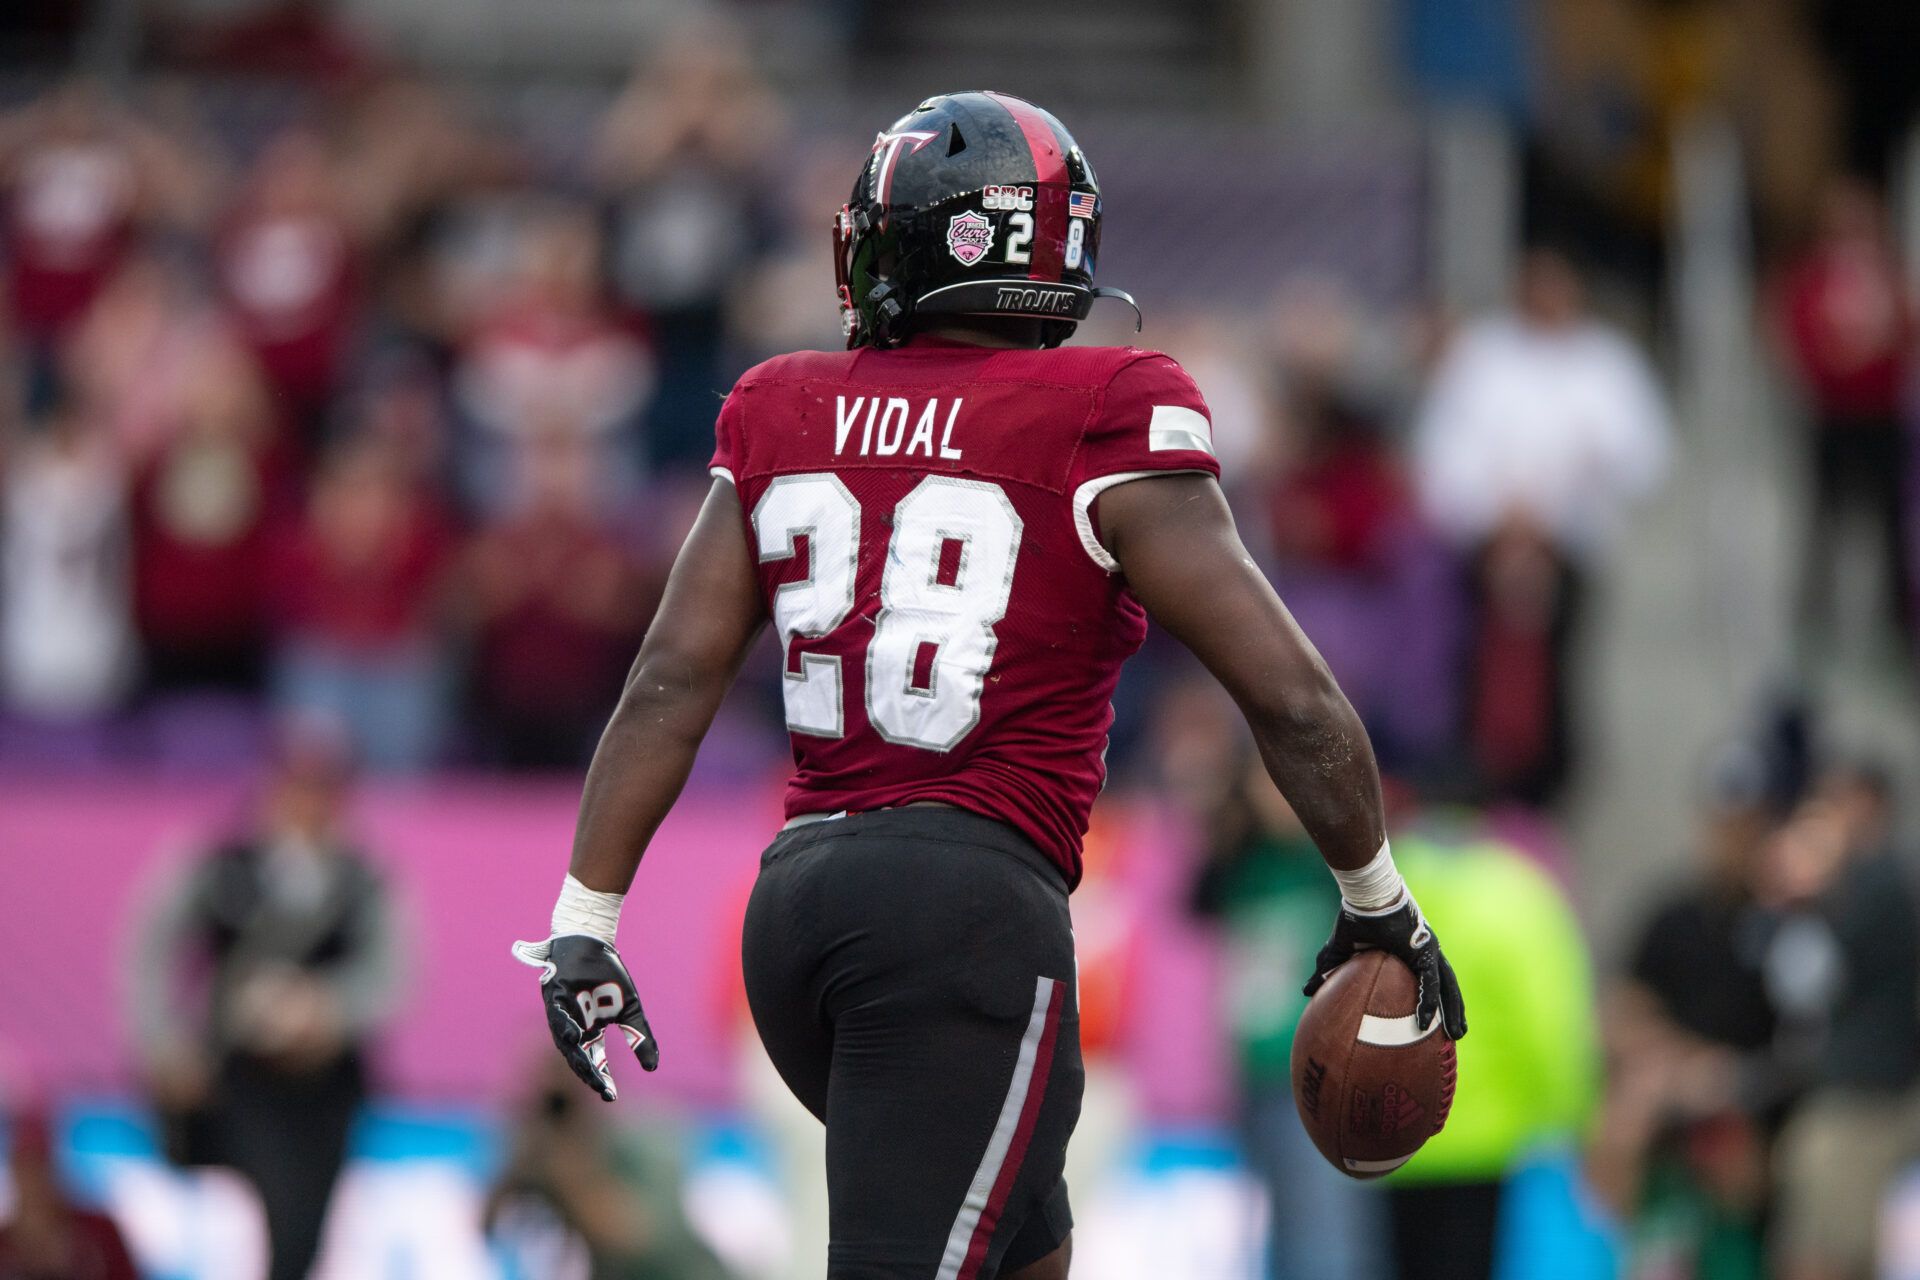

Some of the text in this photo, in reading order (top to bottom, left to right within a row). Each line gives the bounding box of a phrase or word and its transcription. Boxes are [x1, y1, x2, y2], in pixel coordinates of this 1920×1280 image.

[982, 185, 1033, 211] SBC
[951, 221, 989, 238] Cure
[1005, 212, 1085, 269] 2 8
[996, 287, 1076, 312] TROJANS
[834, 395, 963, 460] VIDAL
[751, 472, 1024, 754] 28
